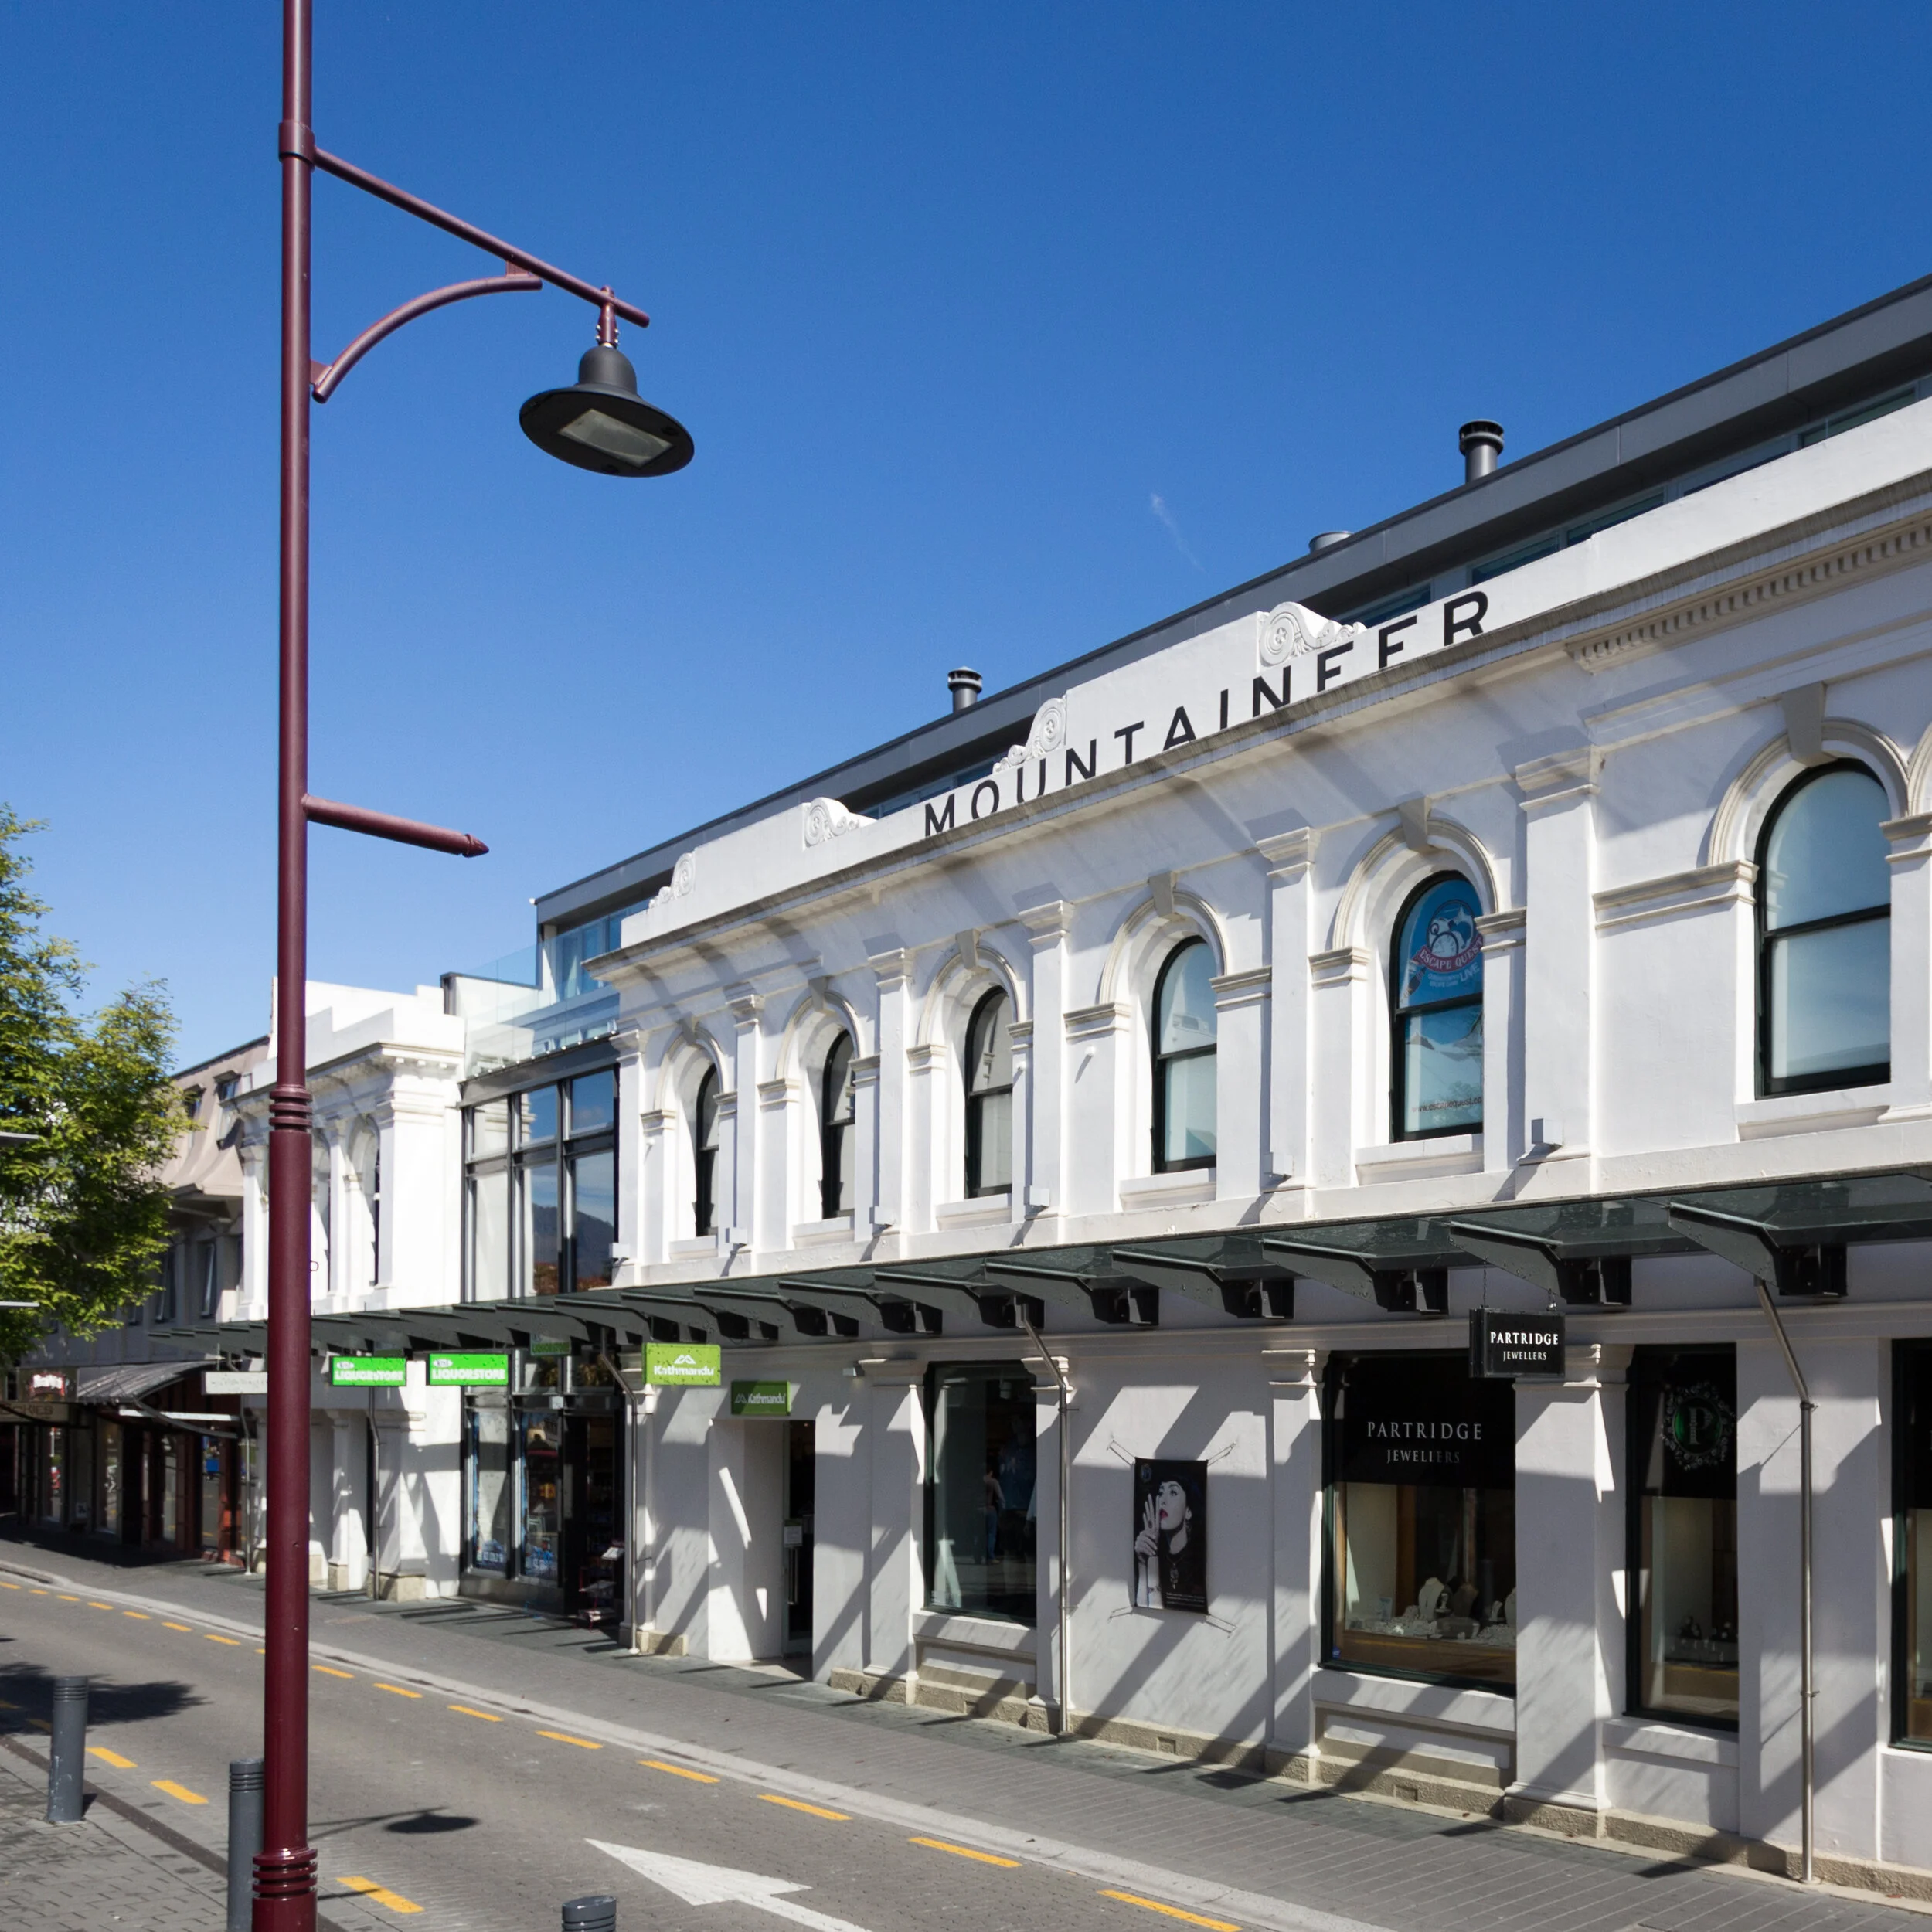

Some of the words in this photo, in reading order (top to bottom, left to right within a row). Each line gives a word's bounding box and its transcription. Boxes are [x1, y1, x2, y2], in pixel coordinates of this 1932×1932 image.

[925, 590, 1488, 838] MOUNTAINEER
[1420, 949, 1452, 969] ESCAPE
[1455, 936, 1483, 967] QUEST
[1459, 962, 1480, 982] LIVE
[1490, 1331, 1560, 1345] PARTRIDGE
[1502, 1350, 1547, 1361] JEWELLERS
[653, 1364, 714, 1376] Kathmandu
[747, 1392, 786, 1404] Kathmandu
[1367, 1420, 1483, 1440] PARTRIDGE
[1386, 1448, 1461, 1464] JEWELLERS
